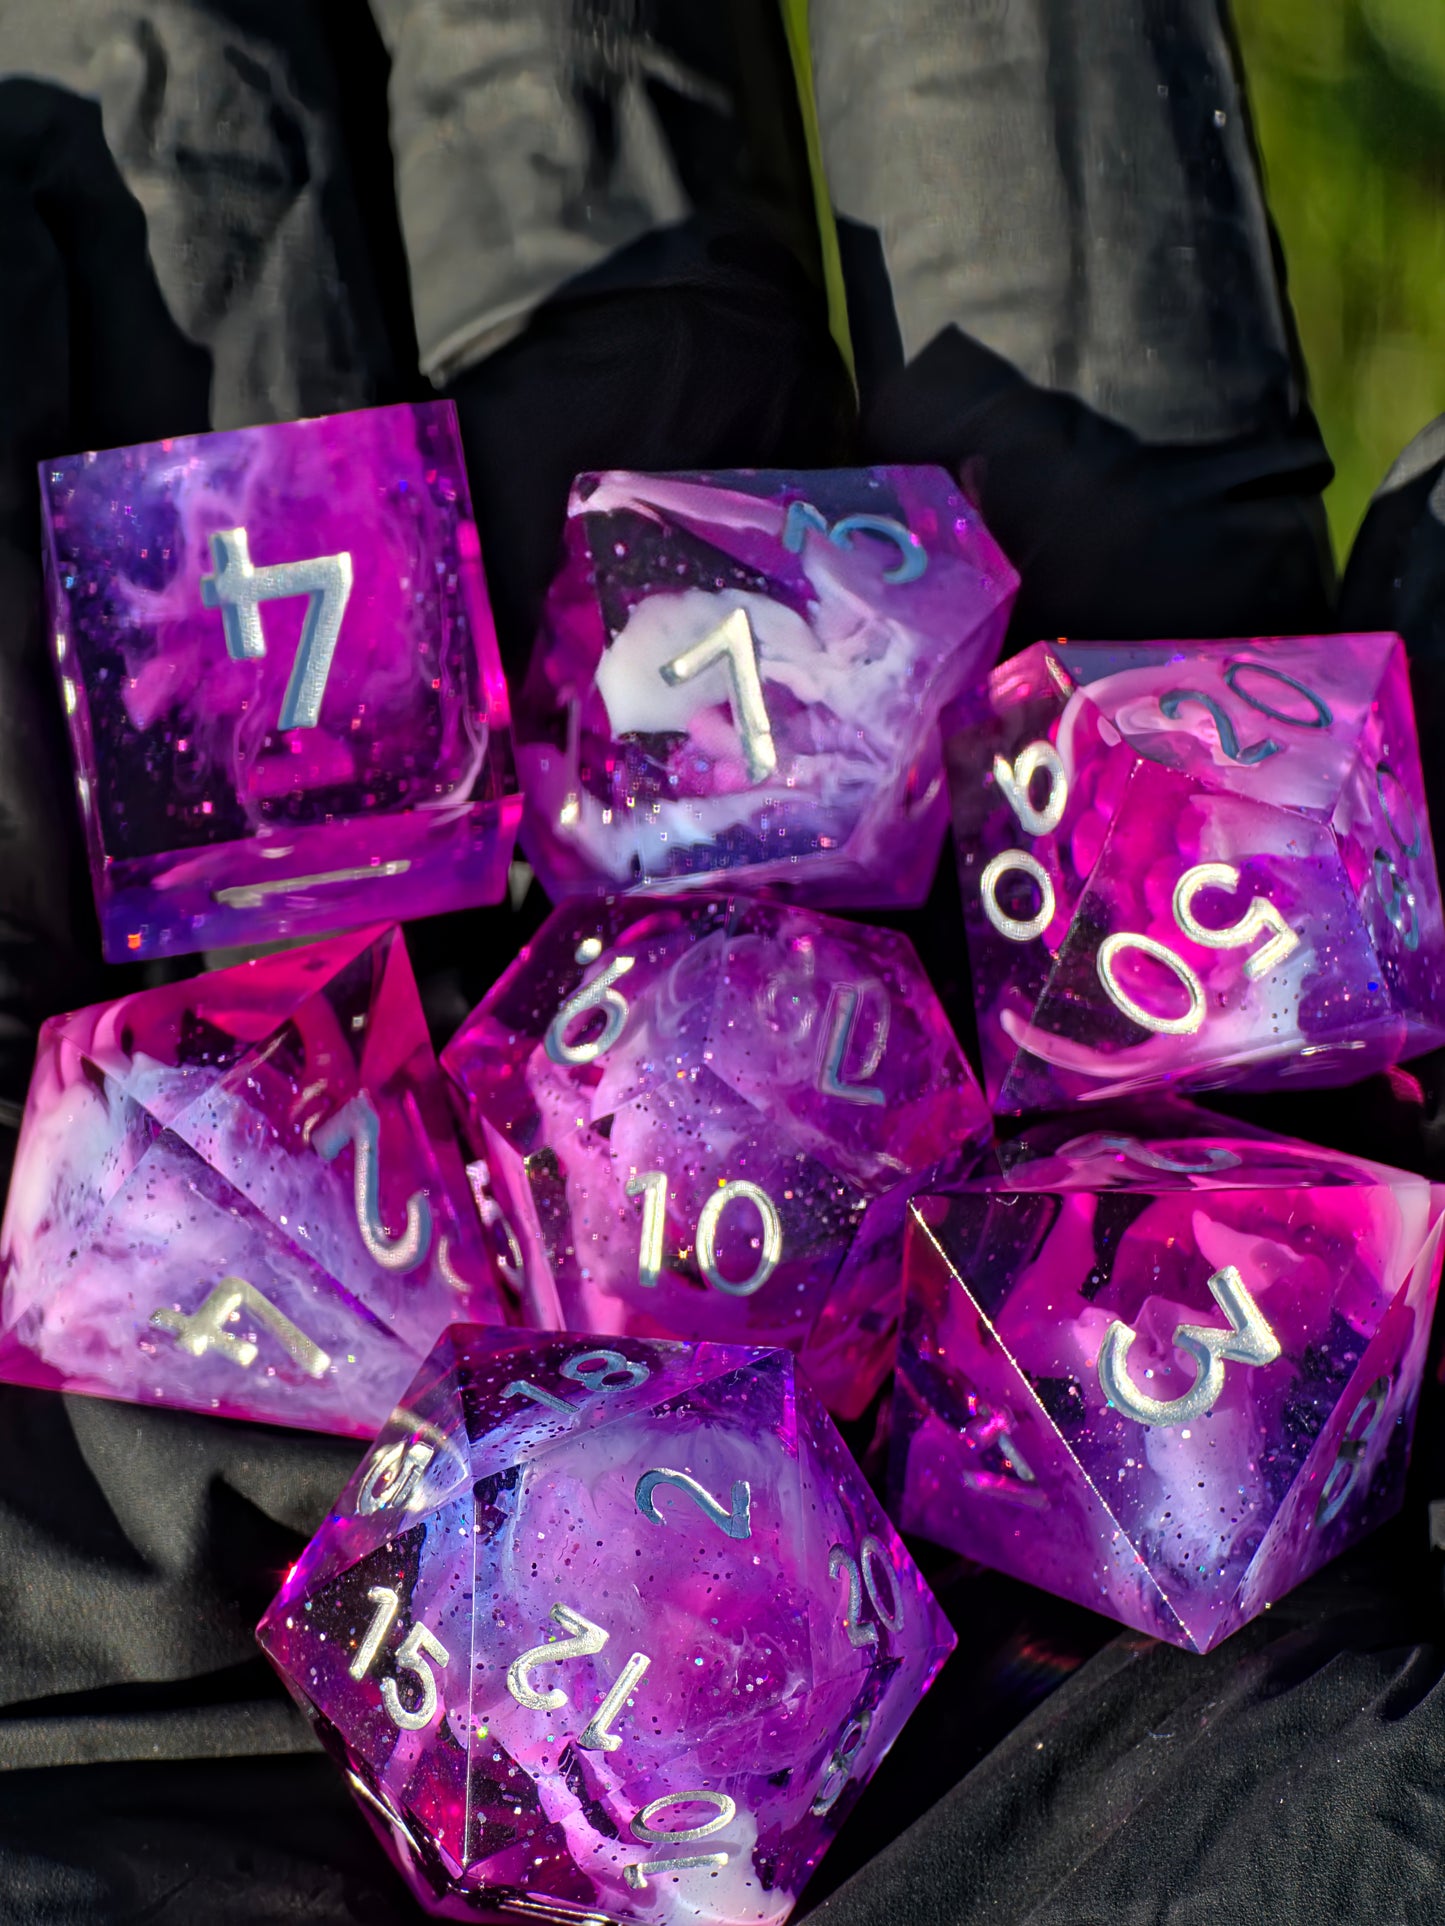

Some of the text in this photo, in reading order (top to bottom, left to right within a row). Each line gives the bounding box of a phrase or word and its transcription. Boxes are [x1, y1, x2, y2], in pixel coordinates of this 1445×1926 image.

[201, 526, 352, 731] 4
[1158, 663, 1332, 764] 20
[1097, 862, 1298, 1034] 50
[626, 1171, 781, 1296] 10
[150, 1276, 331, 1378] 4
[500, 1350, 650, 1416] 18
[1099, 1265, 1281, 1427] 3
[634, 1468, 751, 1539] 2
[829, 1535, 903, 1648] 20
[350, 1587, 449, 1731] 15
[507, 1603, 651, 1752] 12
[624, 1790, 736, 1890] 10
